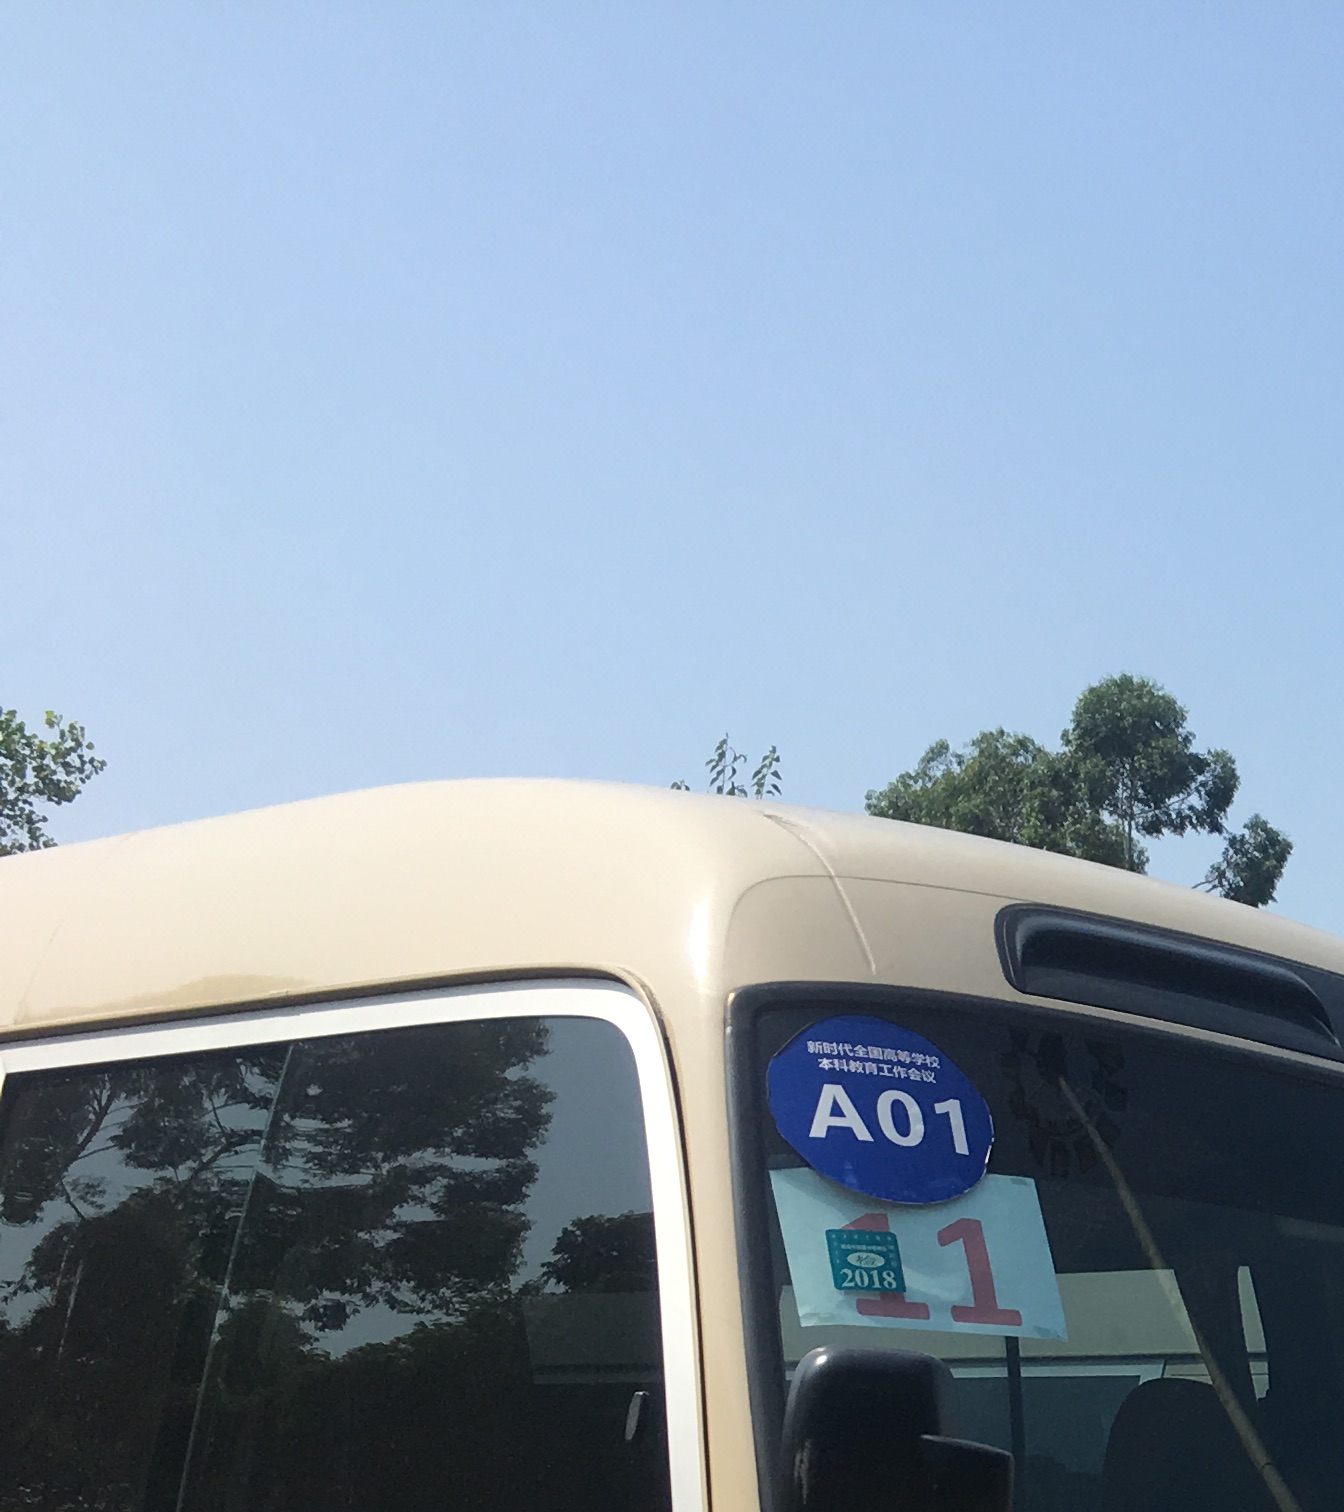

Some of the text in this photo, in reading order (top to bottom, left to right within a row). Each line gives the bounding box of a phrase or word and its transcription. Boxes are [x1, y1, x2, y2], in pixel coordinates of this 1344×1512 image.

[807, 1040, 941, 1069] 新时代全国高等学校
[818, 1058, 937, 1084] 本科教育工作会议
[809, 1084, 970, 1156] A01
[840, 1268, 897, 1289] 2018
